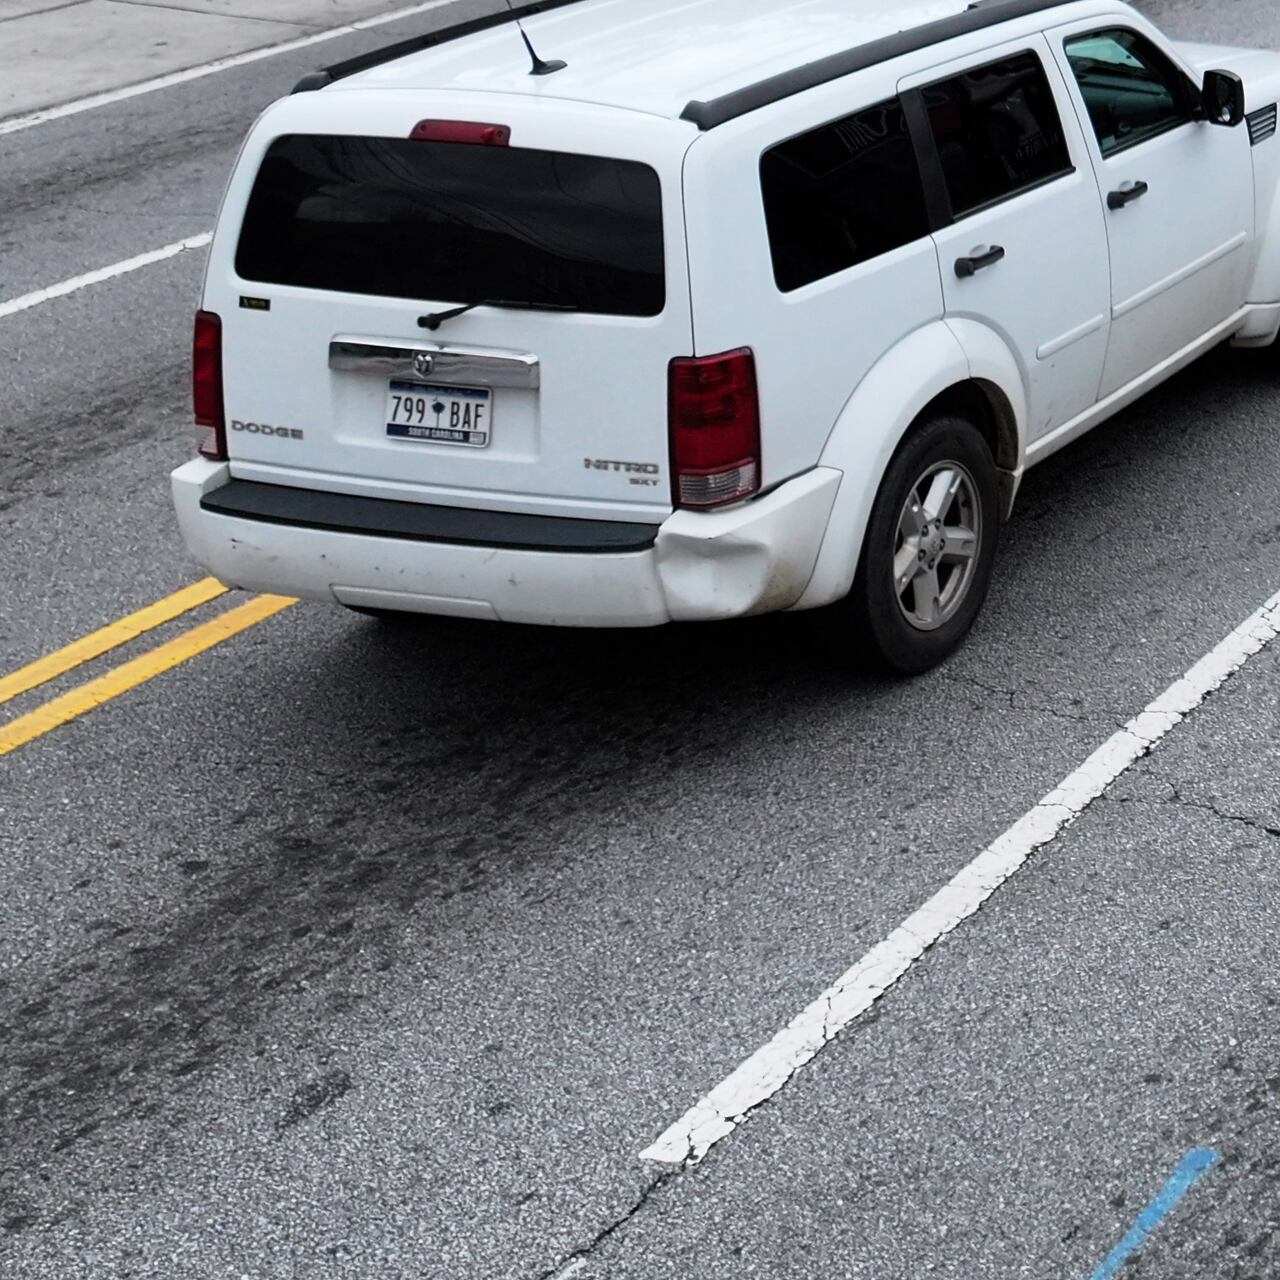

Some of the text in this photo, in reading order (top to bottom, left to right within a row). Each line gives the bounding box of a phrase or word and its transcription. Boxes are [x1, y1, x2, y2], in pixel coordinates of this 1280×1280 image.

[391, 395, 485, 431] 799 BAF
[231, 420, 304, 441] DODGE
[431, 428, 465, 441] CAROLINA
[584, 458, 660, 475] NITRO
[629, 478, 660, 487] SXT
